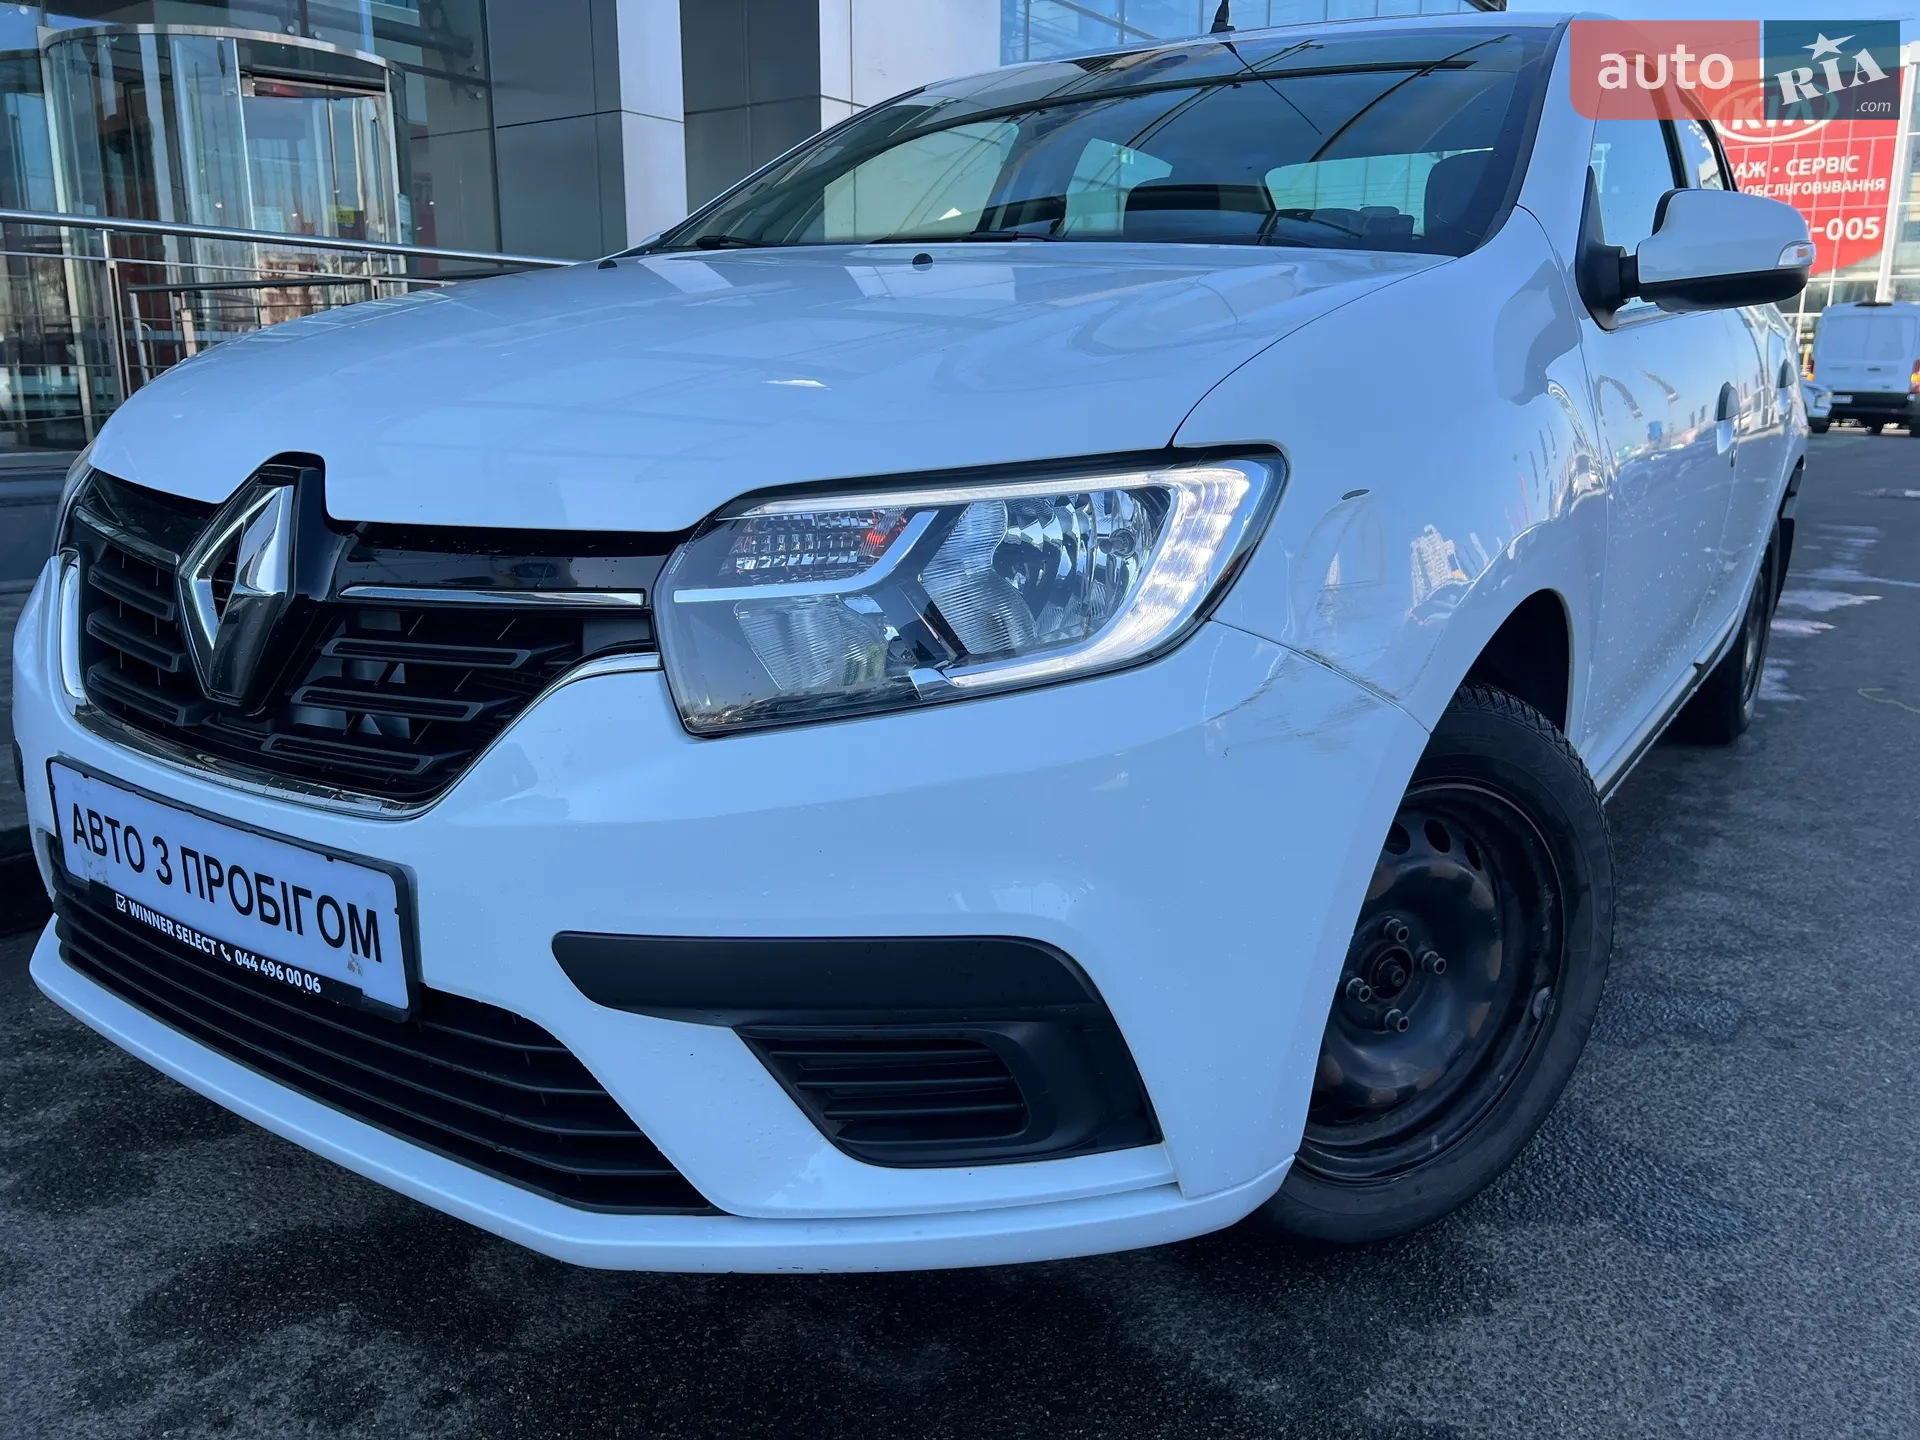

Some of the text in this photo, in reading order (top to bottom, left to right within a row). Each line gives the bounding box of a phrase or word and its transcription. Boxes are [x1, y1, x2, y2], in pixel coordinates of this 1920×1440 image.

[1730, 155, 1860, 179] АЖ СЕРВІС
[1805, 217, 1881, 240] -005
[73, 802, 146, 874] АВТО
[180, 845, 383, 963] ПРОБІГОМ
[128, 900, 321, 993] WINNER SELECT 044 496 00 06
